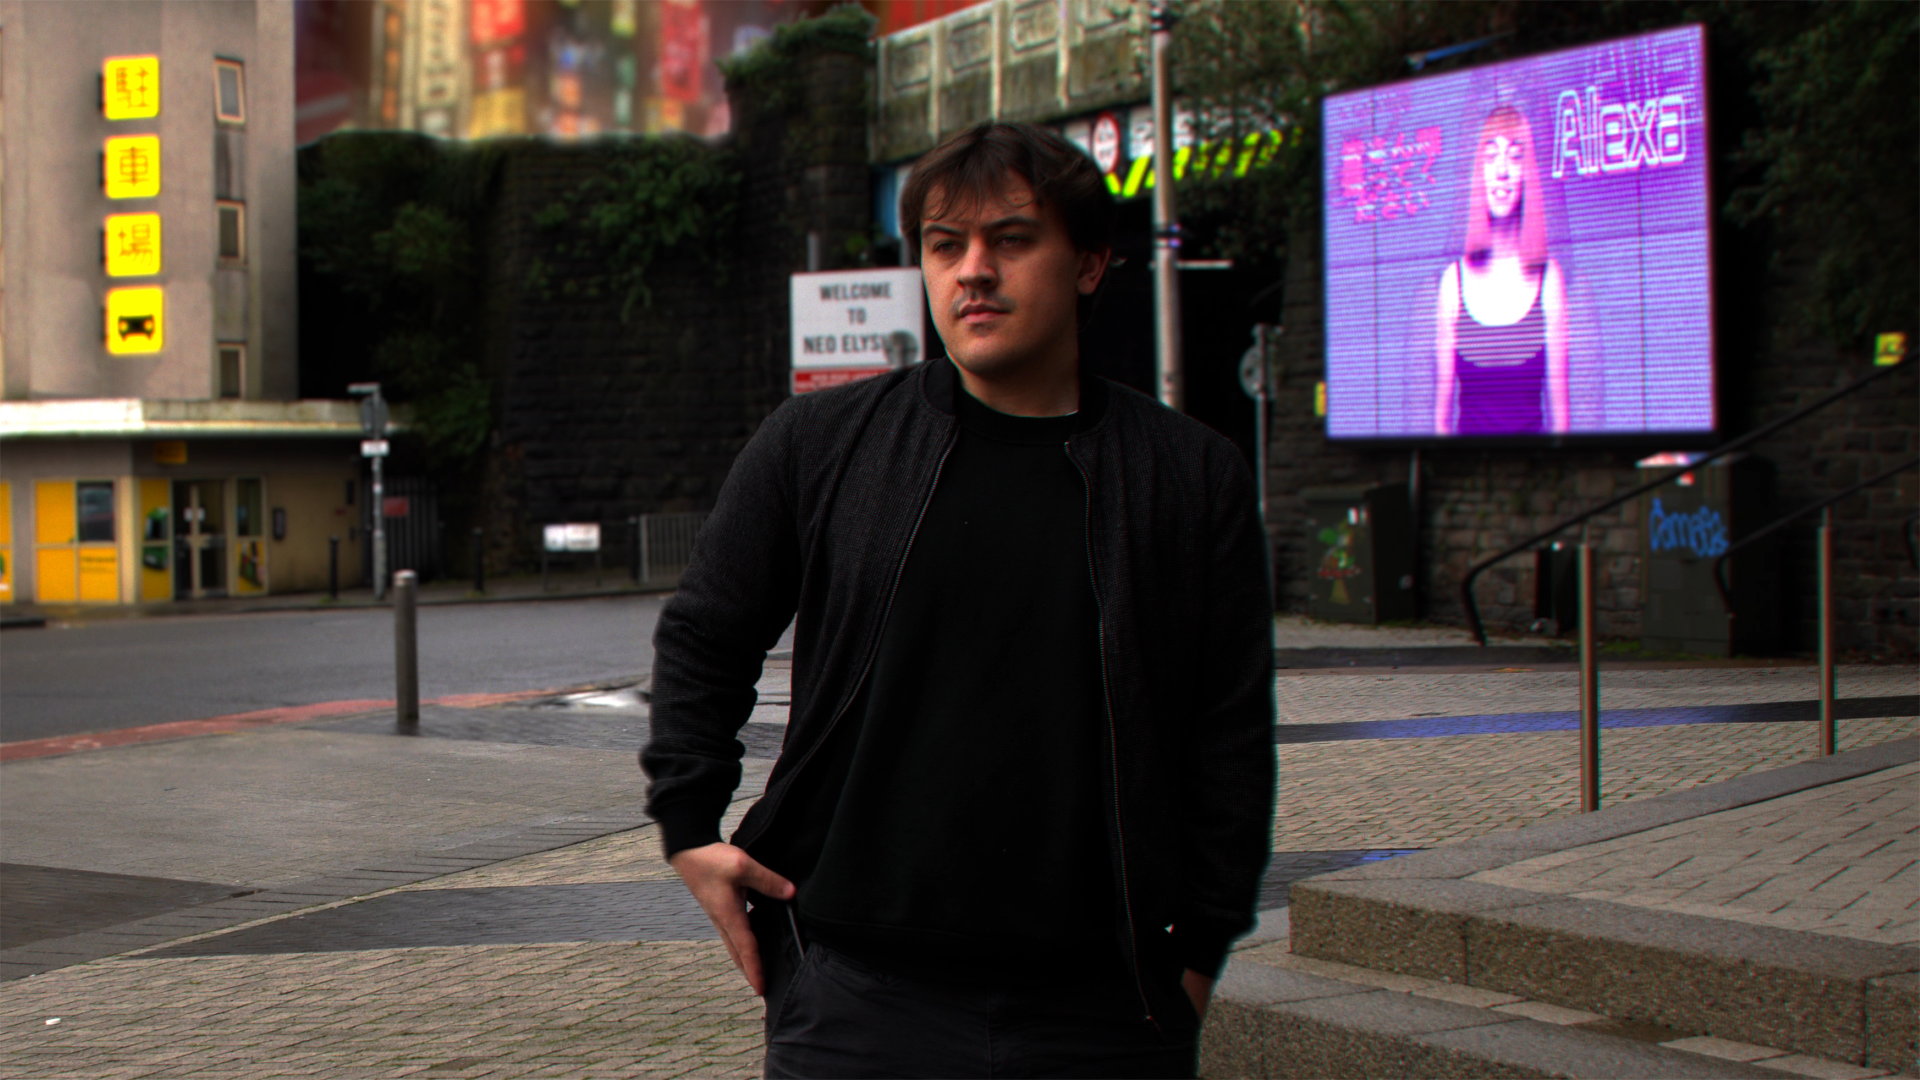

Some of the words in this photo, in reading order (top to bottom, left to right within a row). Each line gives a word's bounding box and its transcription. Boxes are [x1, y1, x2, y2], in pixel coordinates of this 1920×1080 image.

[1554, 86, 1687, 176] Alexa
[820, 283, 891, 301] WELCOME
[848, 308, 867, 325] TO
[804, 334, 837, 354] NEO
